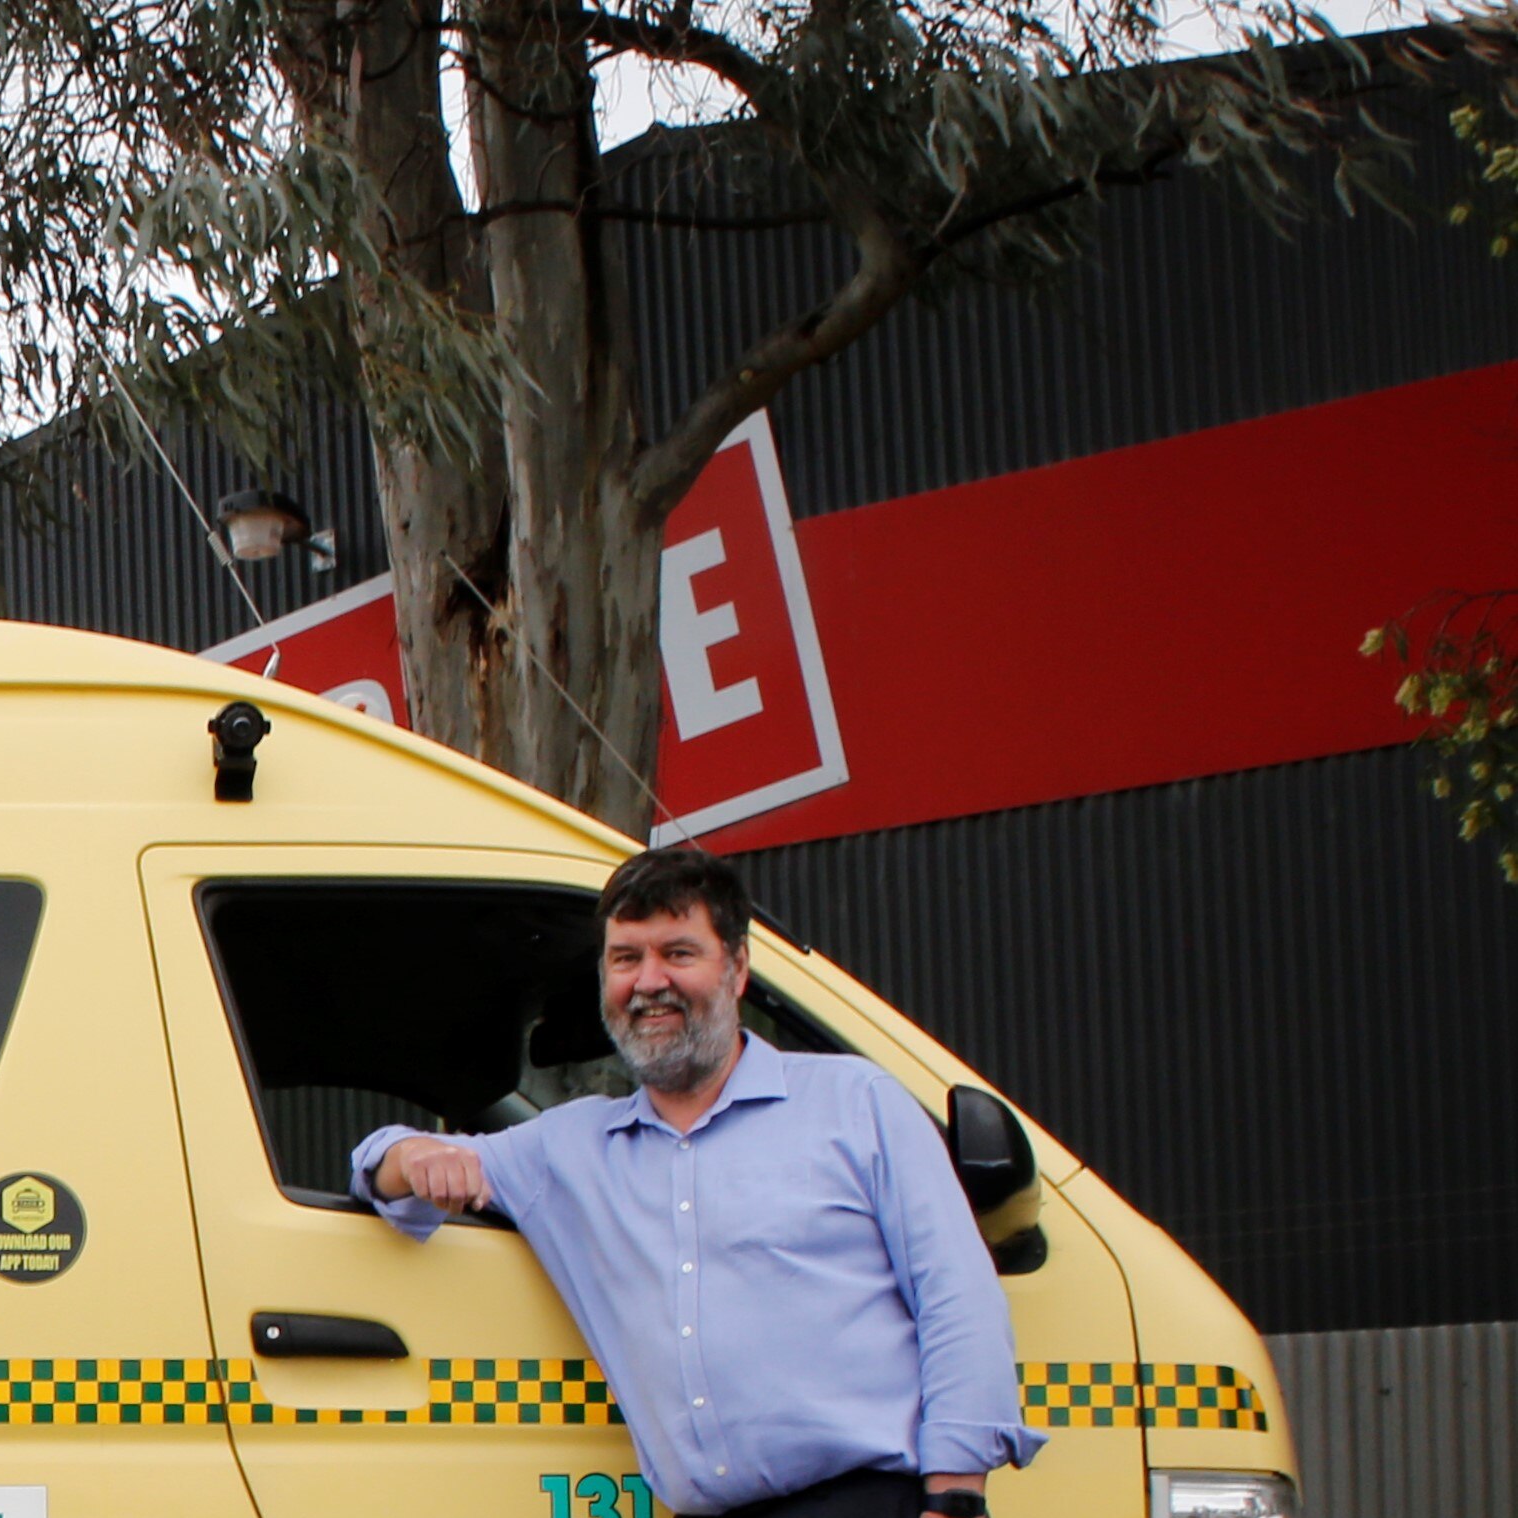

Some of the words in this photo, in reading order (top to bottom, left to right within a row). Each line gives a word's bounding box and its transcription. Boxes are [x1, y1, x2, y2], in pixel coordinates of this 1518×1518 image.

[49, 1233, 71, 1251] OUR
[0, 1254, 21, 1271] APP
[22, 1254, 60, 1271] TODAY!
